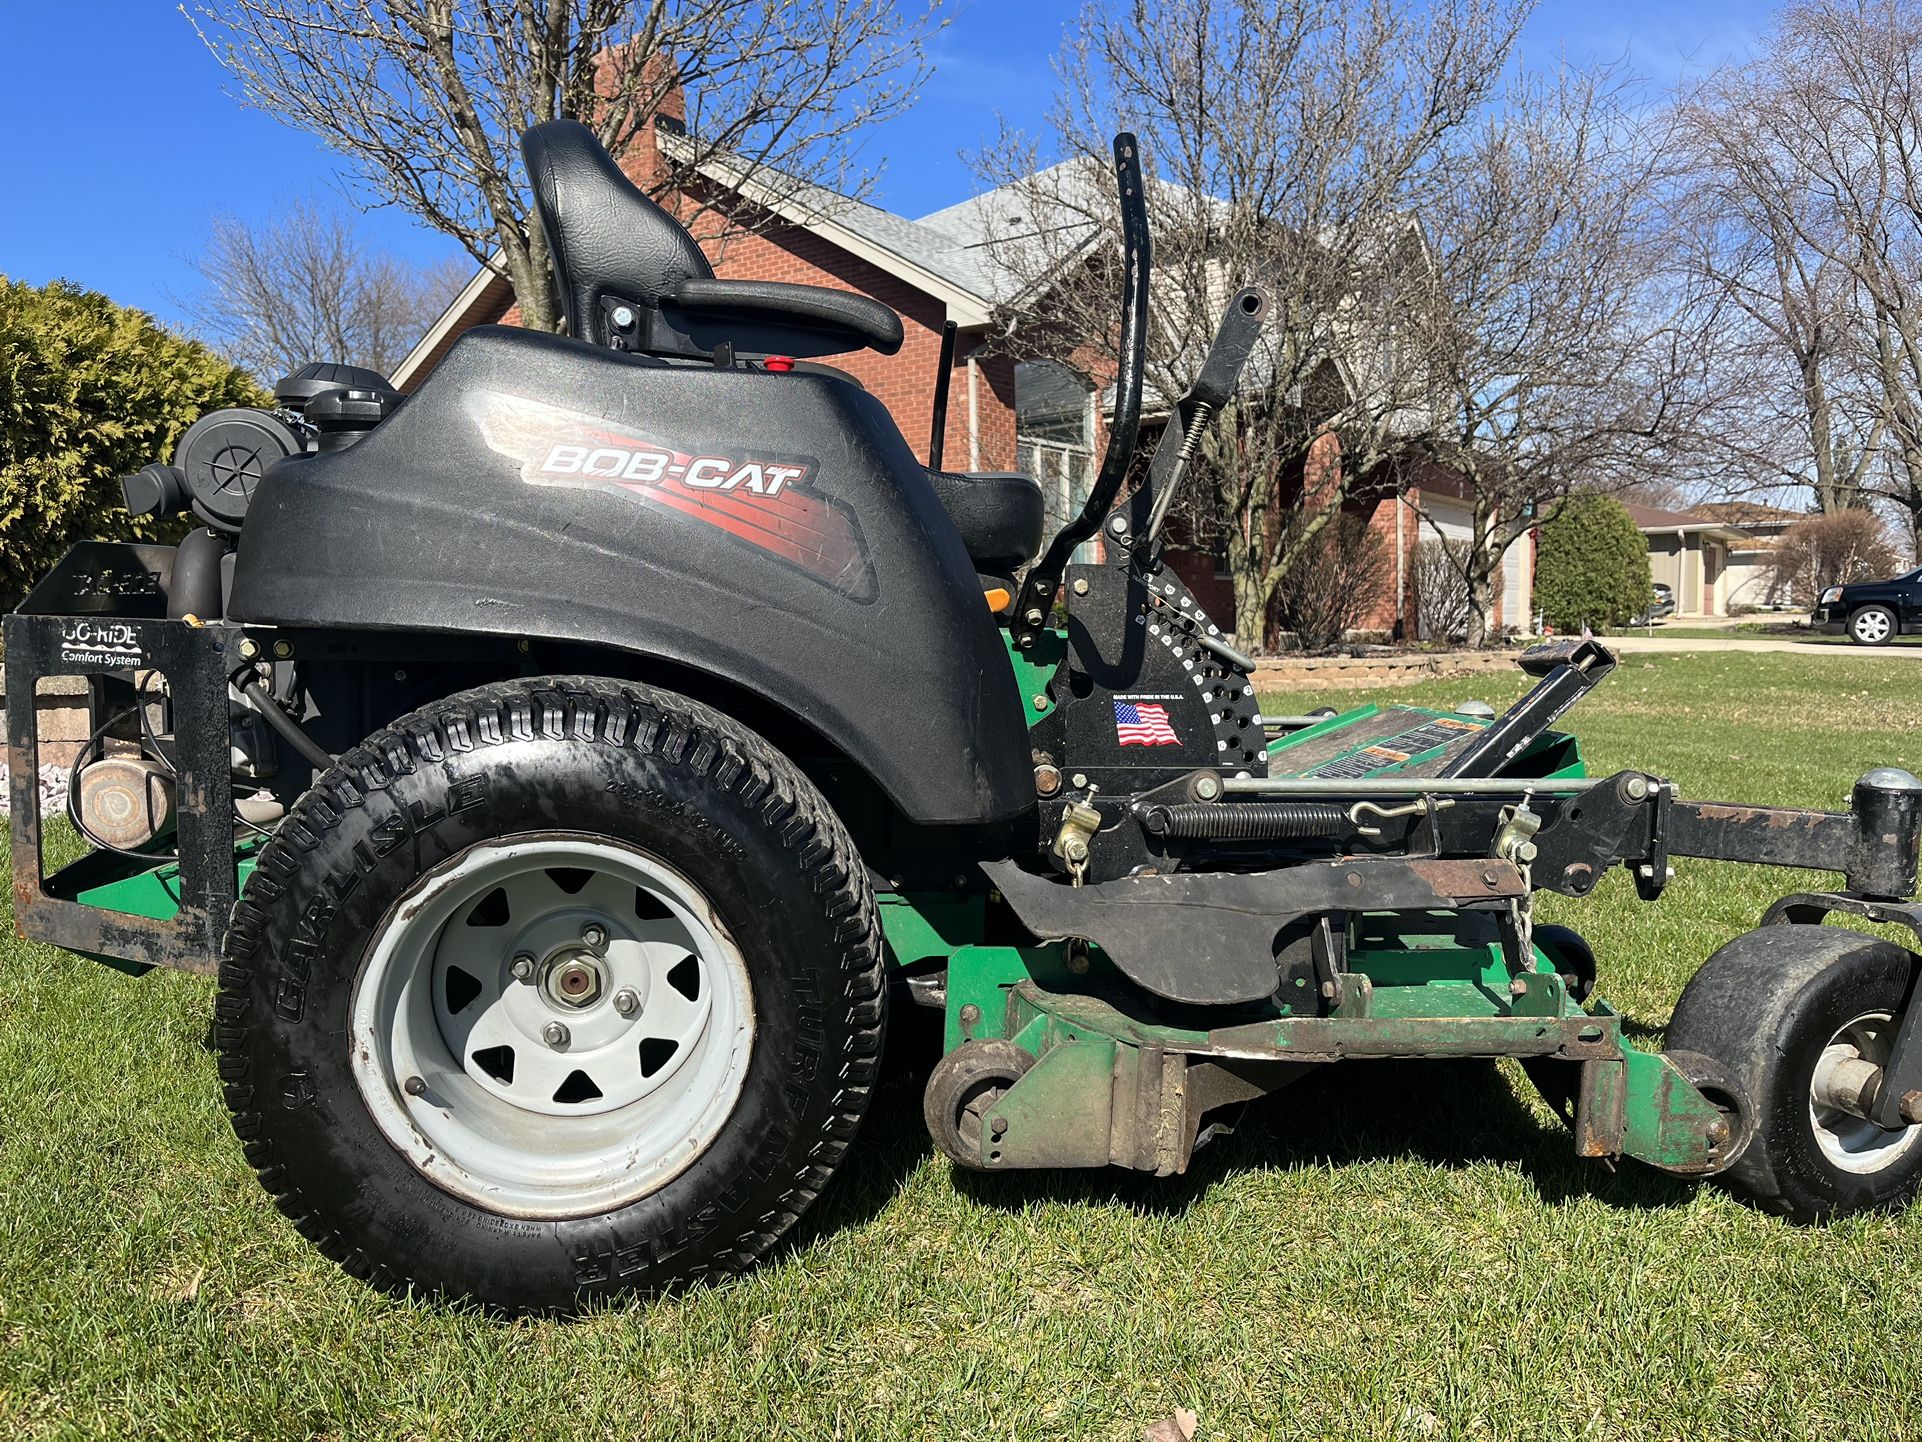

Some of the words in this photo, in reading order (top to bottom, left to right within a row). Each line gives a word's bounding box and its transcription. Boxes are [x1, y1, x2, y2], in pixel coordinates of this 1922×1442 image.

[539, 444, 802, 495] BOB-CAT
[61, 650, 103, 664] Comfort
[104, 653, 141, 667] System
[275, 773, 487, 1024] CARLISLE
[787, 967, 824, 1120] TURF
[574, 1121, 793, 1285] MASTER
